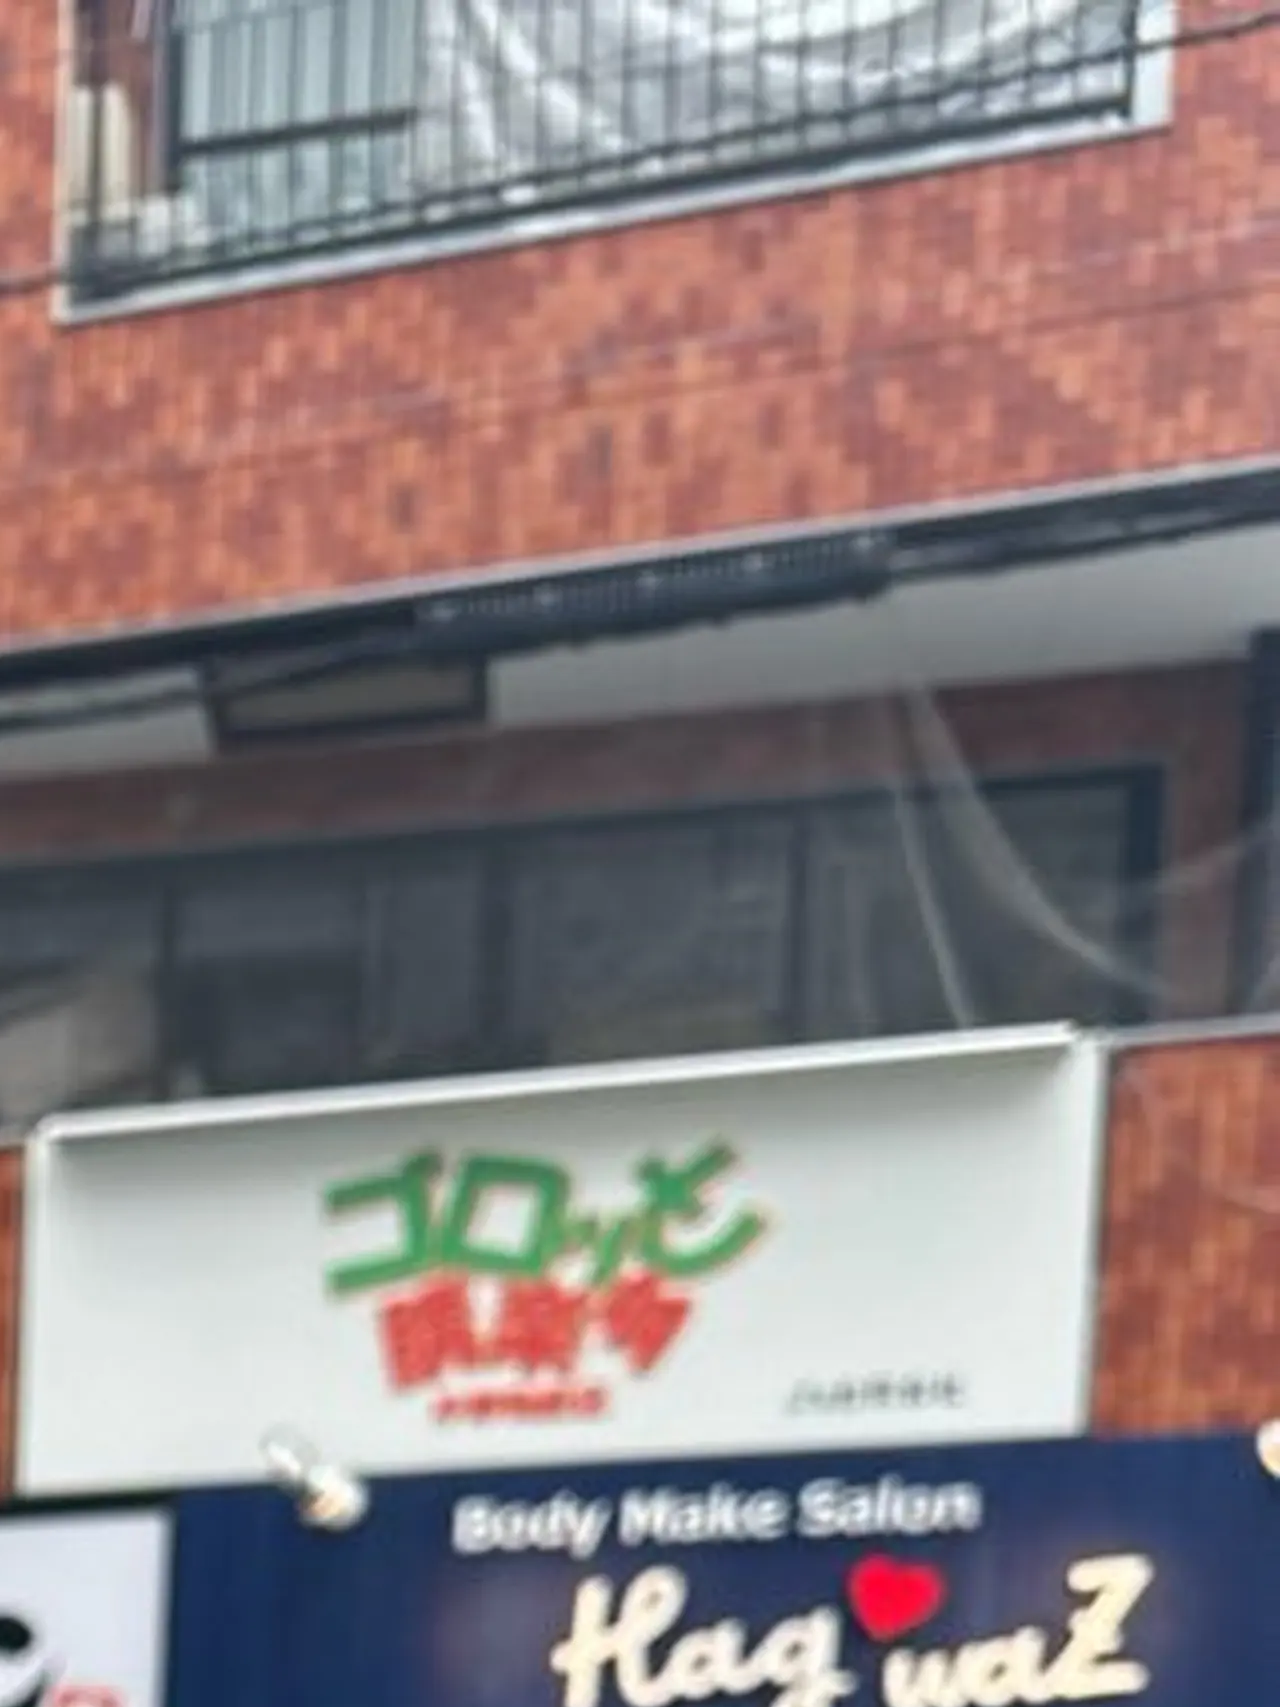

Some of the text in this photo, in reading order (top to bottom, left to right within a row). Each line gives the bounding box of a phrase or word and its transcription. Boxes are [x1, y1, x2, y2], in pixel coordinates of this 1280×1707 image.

[452, 1476, 983, 1558] Body Make Salon
